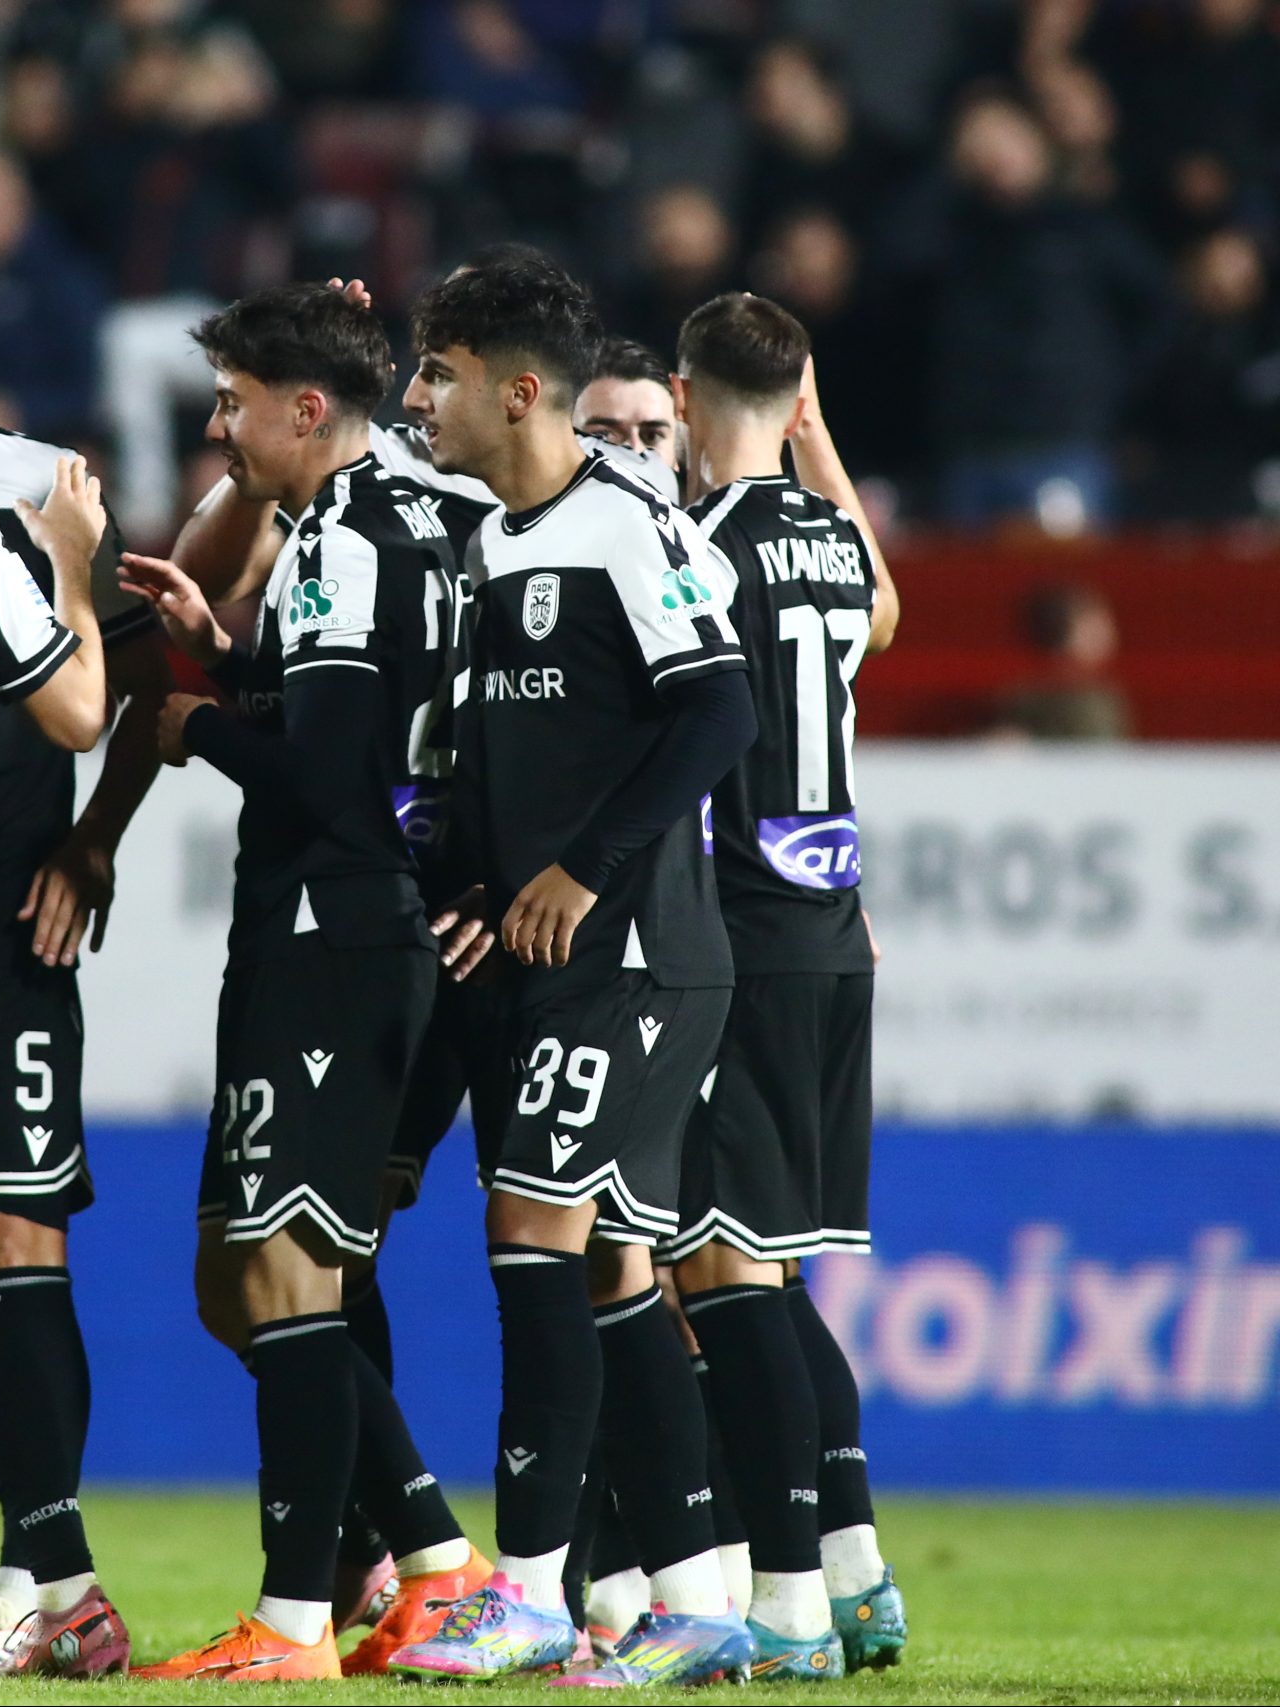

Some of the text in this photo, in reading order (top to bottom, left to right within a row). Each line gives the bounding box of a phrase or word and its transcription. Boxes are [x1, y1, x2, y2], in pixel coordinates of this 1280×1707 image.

[15, 1030, 54, 1112] 5
[517, 1037, 611, 1128] 39
[222, 1077, 275, 1163] 22
[19, 1499, 68, 1531] PAOK
